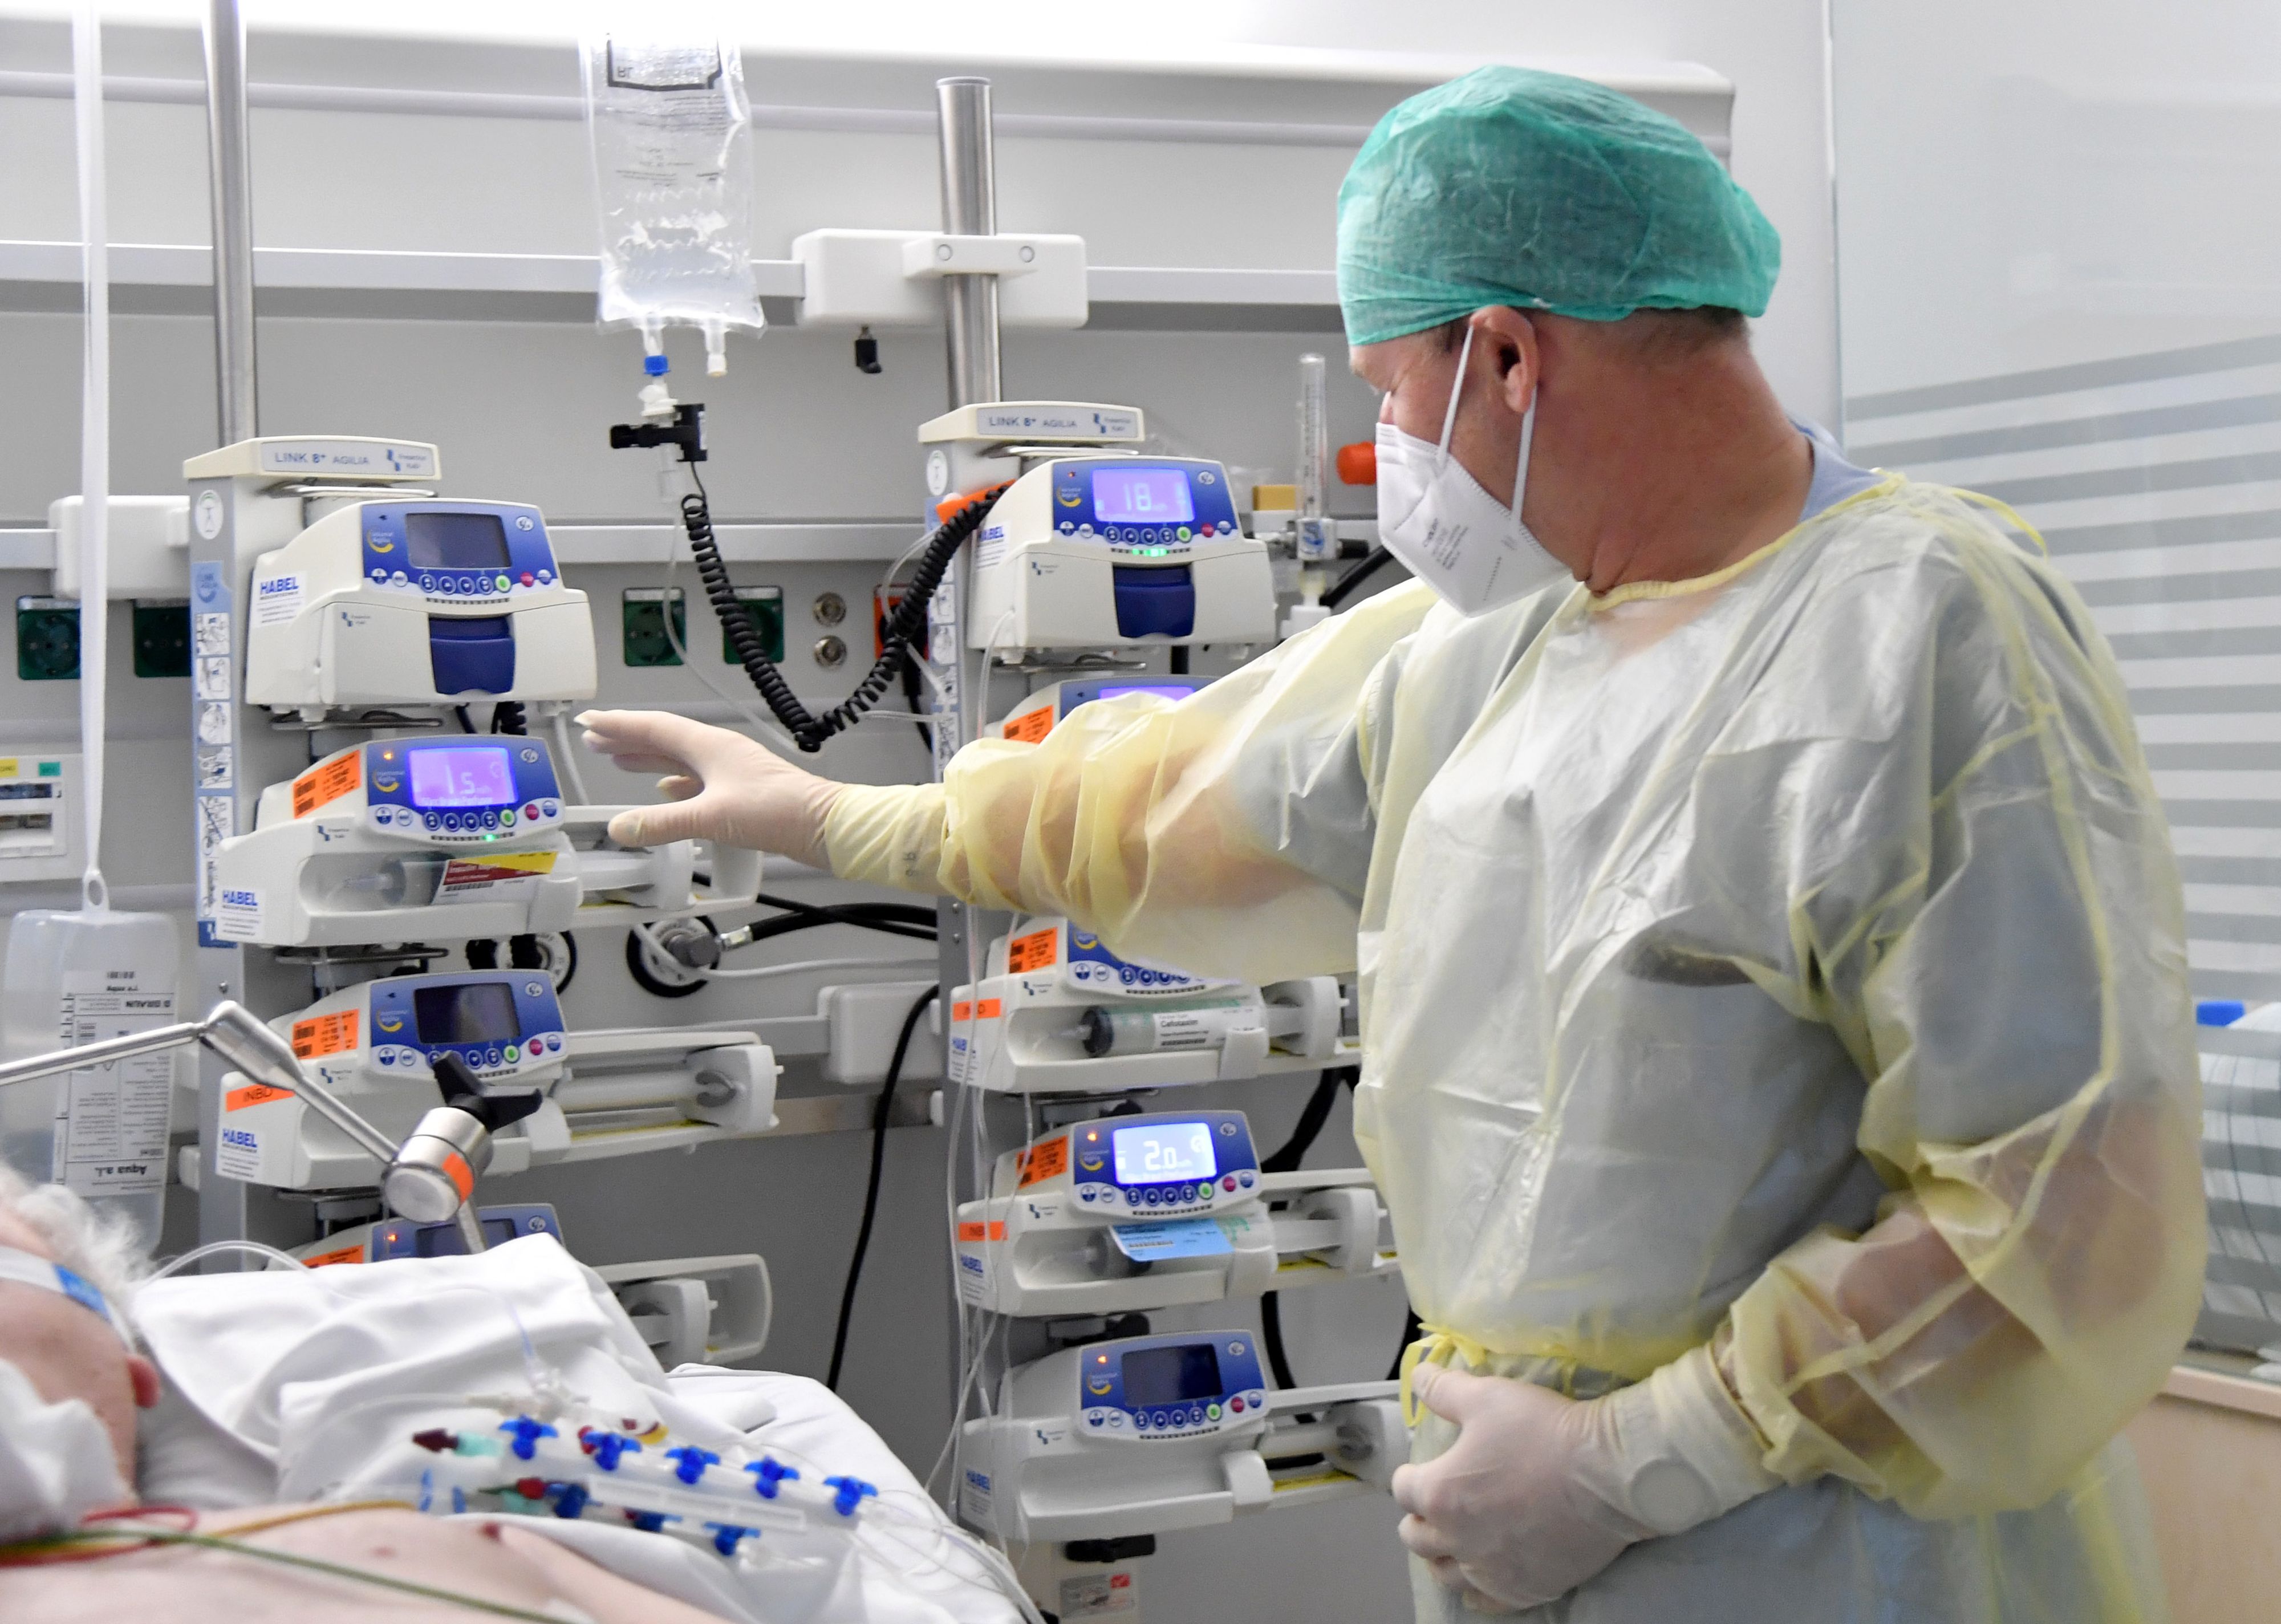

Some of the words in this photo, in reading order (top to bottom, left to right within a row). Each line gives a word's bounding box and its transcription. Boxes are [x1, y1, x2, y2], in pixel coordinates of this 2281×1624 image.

[988, 417, 1020, 427] LINK
[275, 452, 308, 463] LINK
[332, 456, 370, 465] AGILIA
[1123, 483, 1152, 511] 18
[259, 576, 299, 595] HABEL
[222, 890, 258, 906] HABEL
[126, 1000, 161, 1008] BRAUN
[222, 1128, 258, 1148] HABEL
[117, 1163, 148, 1175] Aqua
